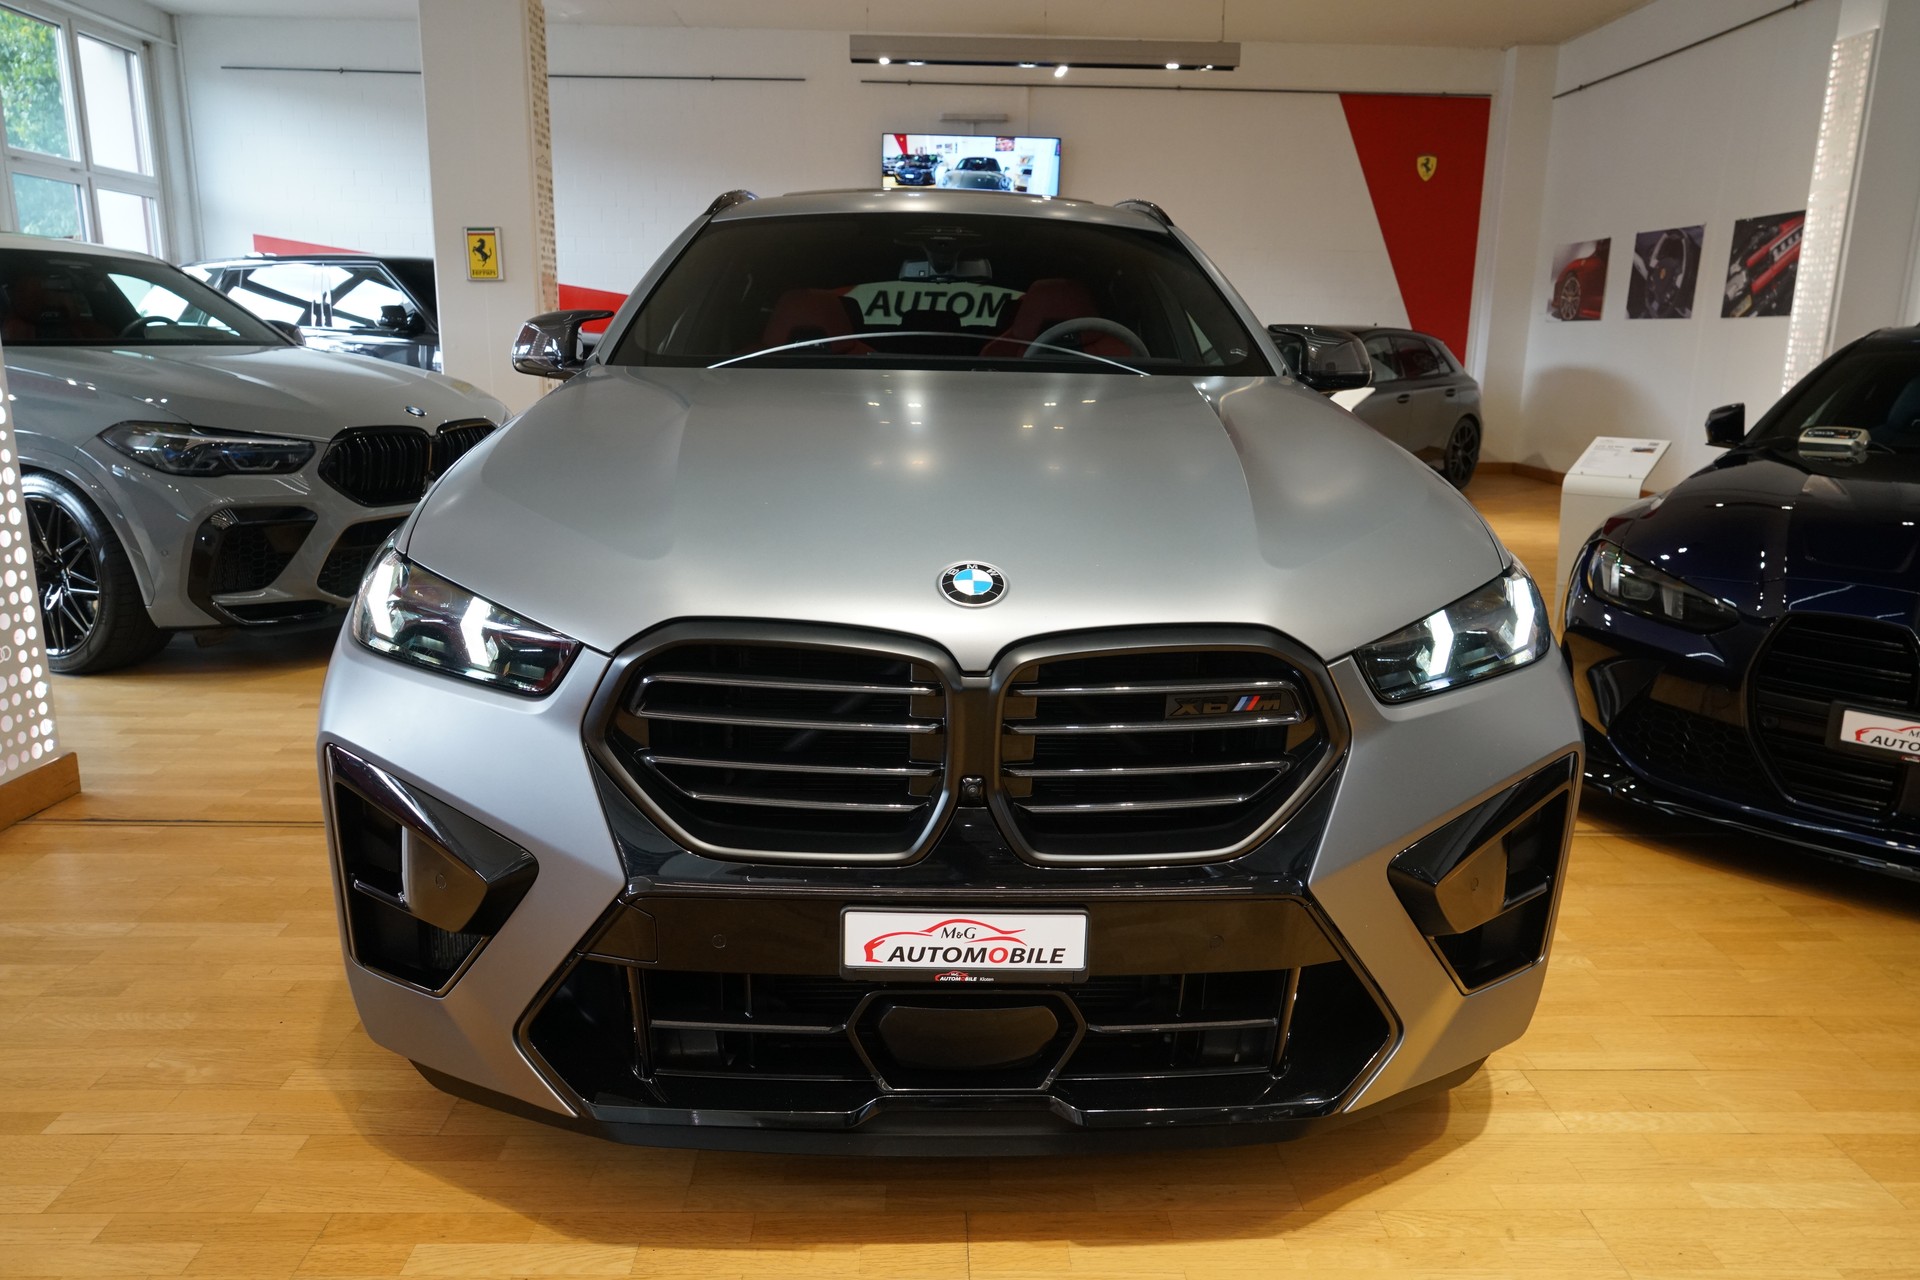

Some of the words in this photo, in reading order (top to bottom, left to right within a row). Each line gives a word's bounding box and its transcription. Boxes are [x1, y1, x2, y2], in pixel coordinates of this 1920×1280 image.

[865, 290, 1012, 318] AUTOM
[946, 563, 999, 577] BMW
[941, 927, 977, 940] M&G
[887, 946, 1066, 964] AUTOMOBILE
